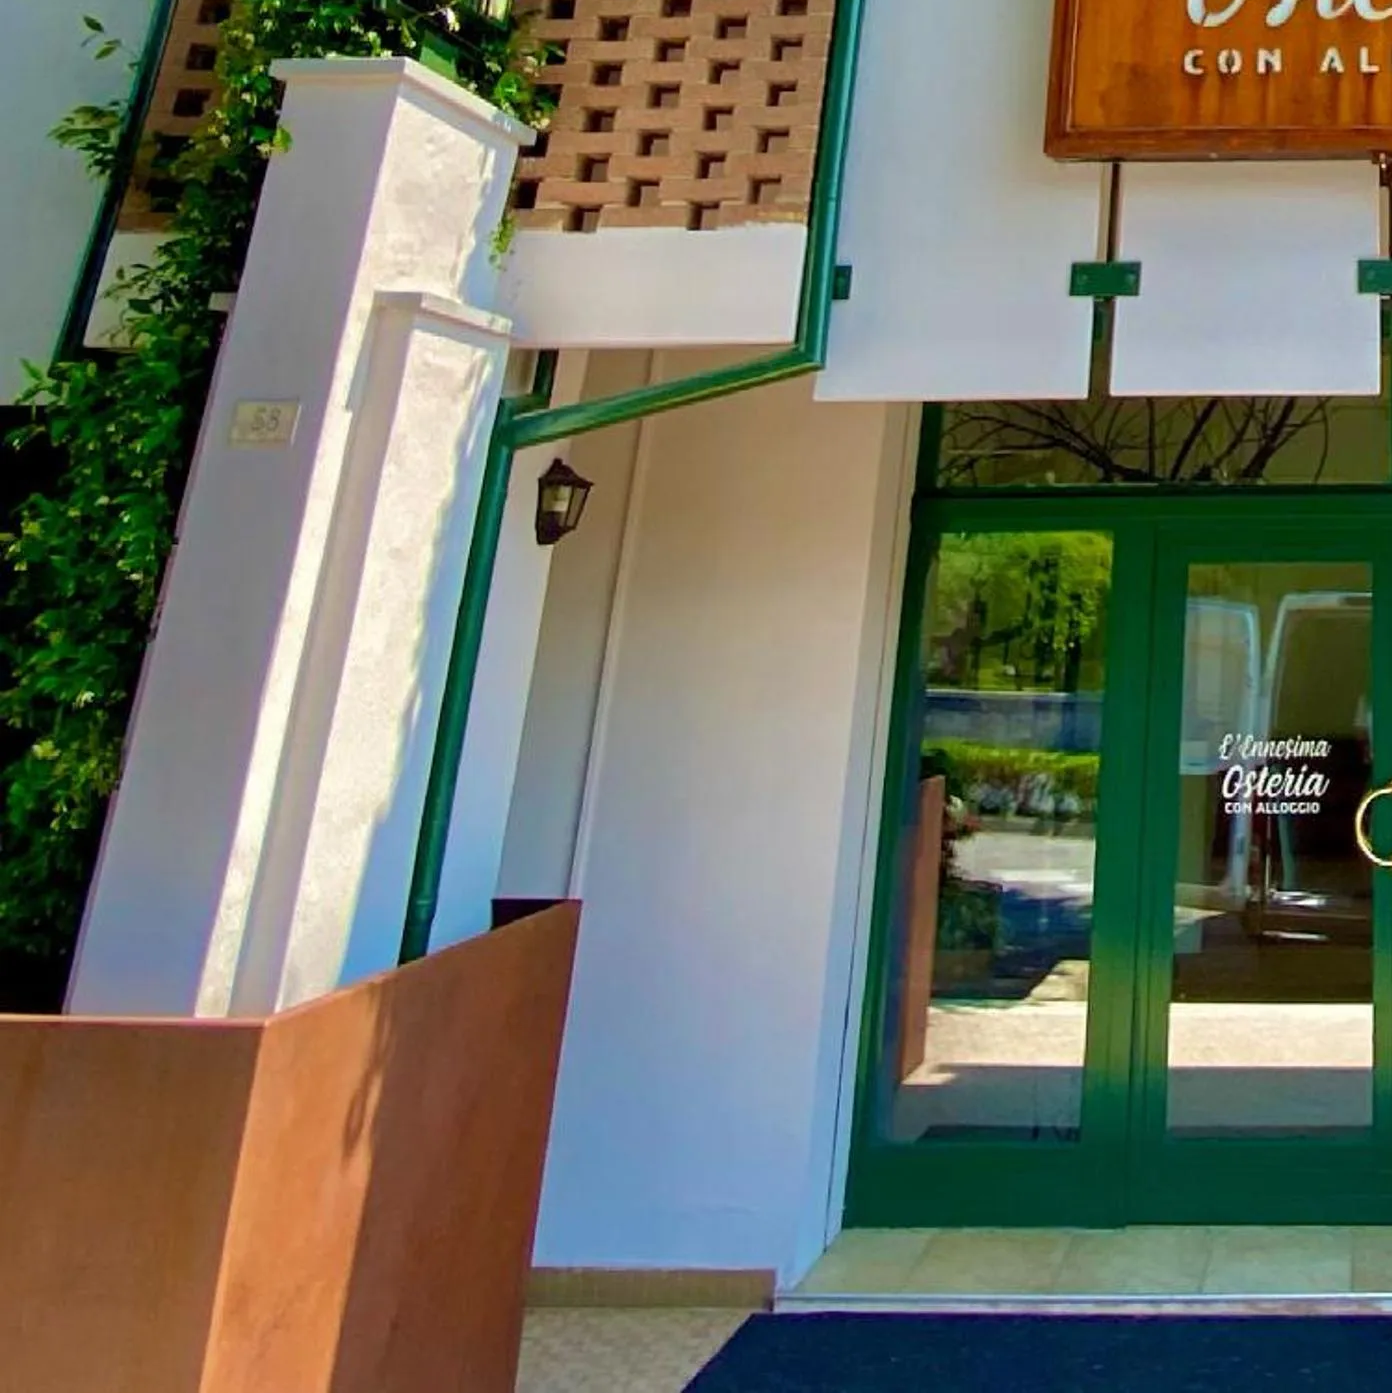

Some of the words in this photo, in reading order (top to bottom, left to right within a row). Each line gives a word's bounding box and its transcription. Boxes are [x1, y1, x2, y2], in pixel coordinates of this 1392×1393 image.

[1183, 48, 1284, 75] CON
[1219, 733, 1332, 760] L'Ennesima
[1222, 764, 1330, 798] Osteria
[1225, 802, 1252, 814] CON
